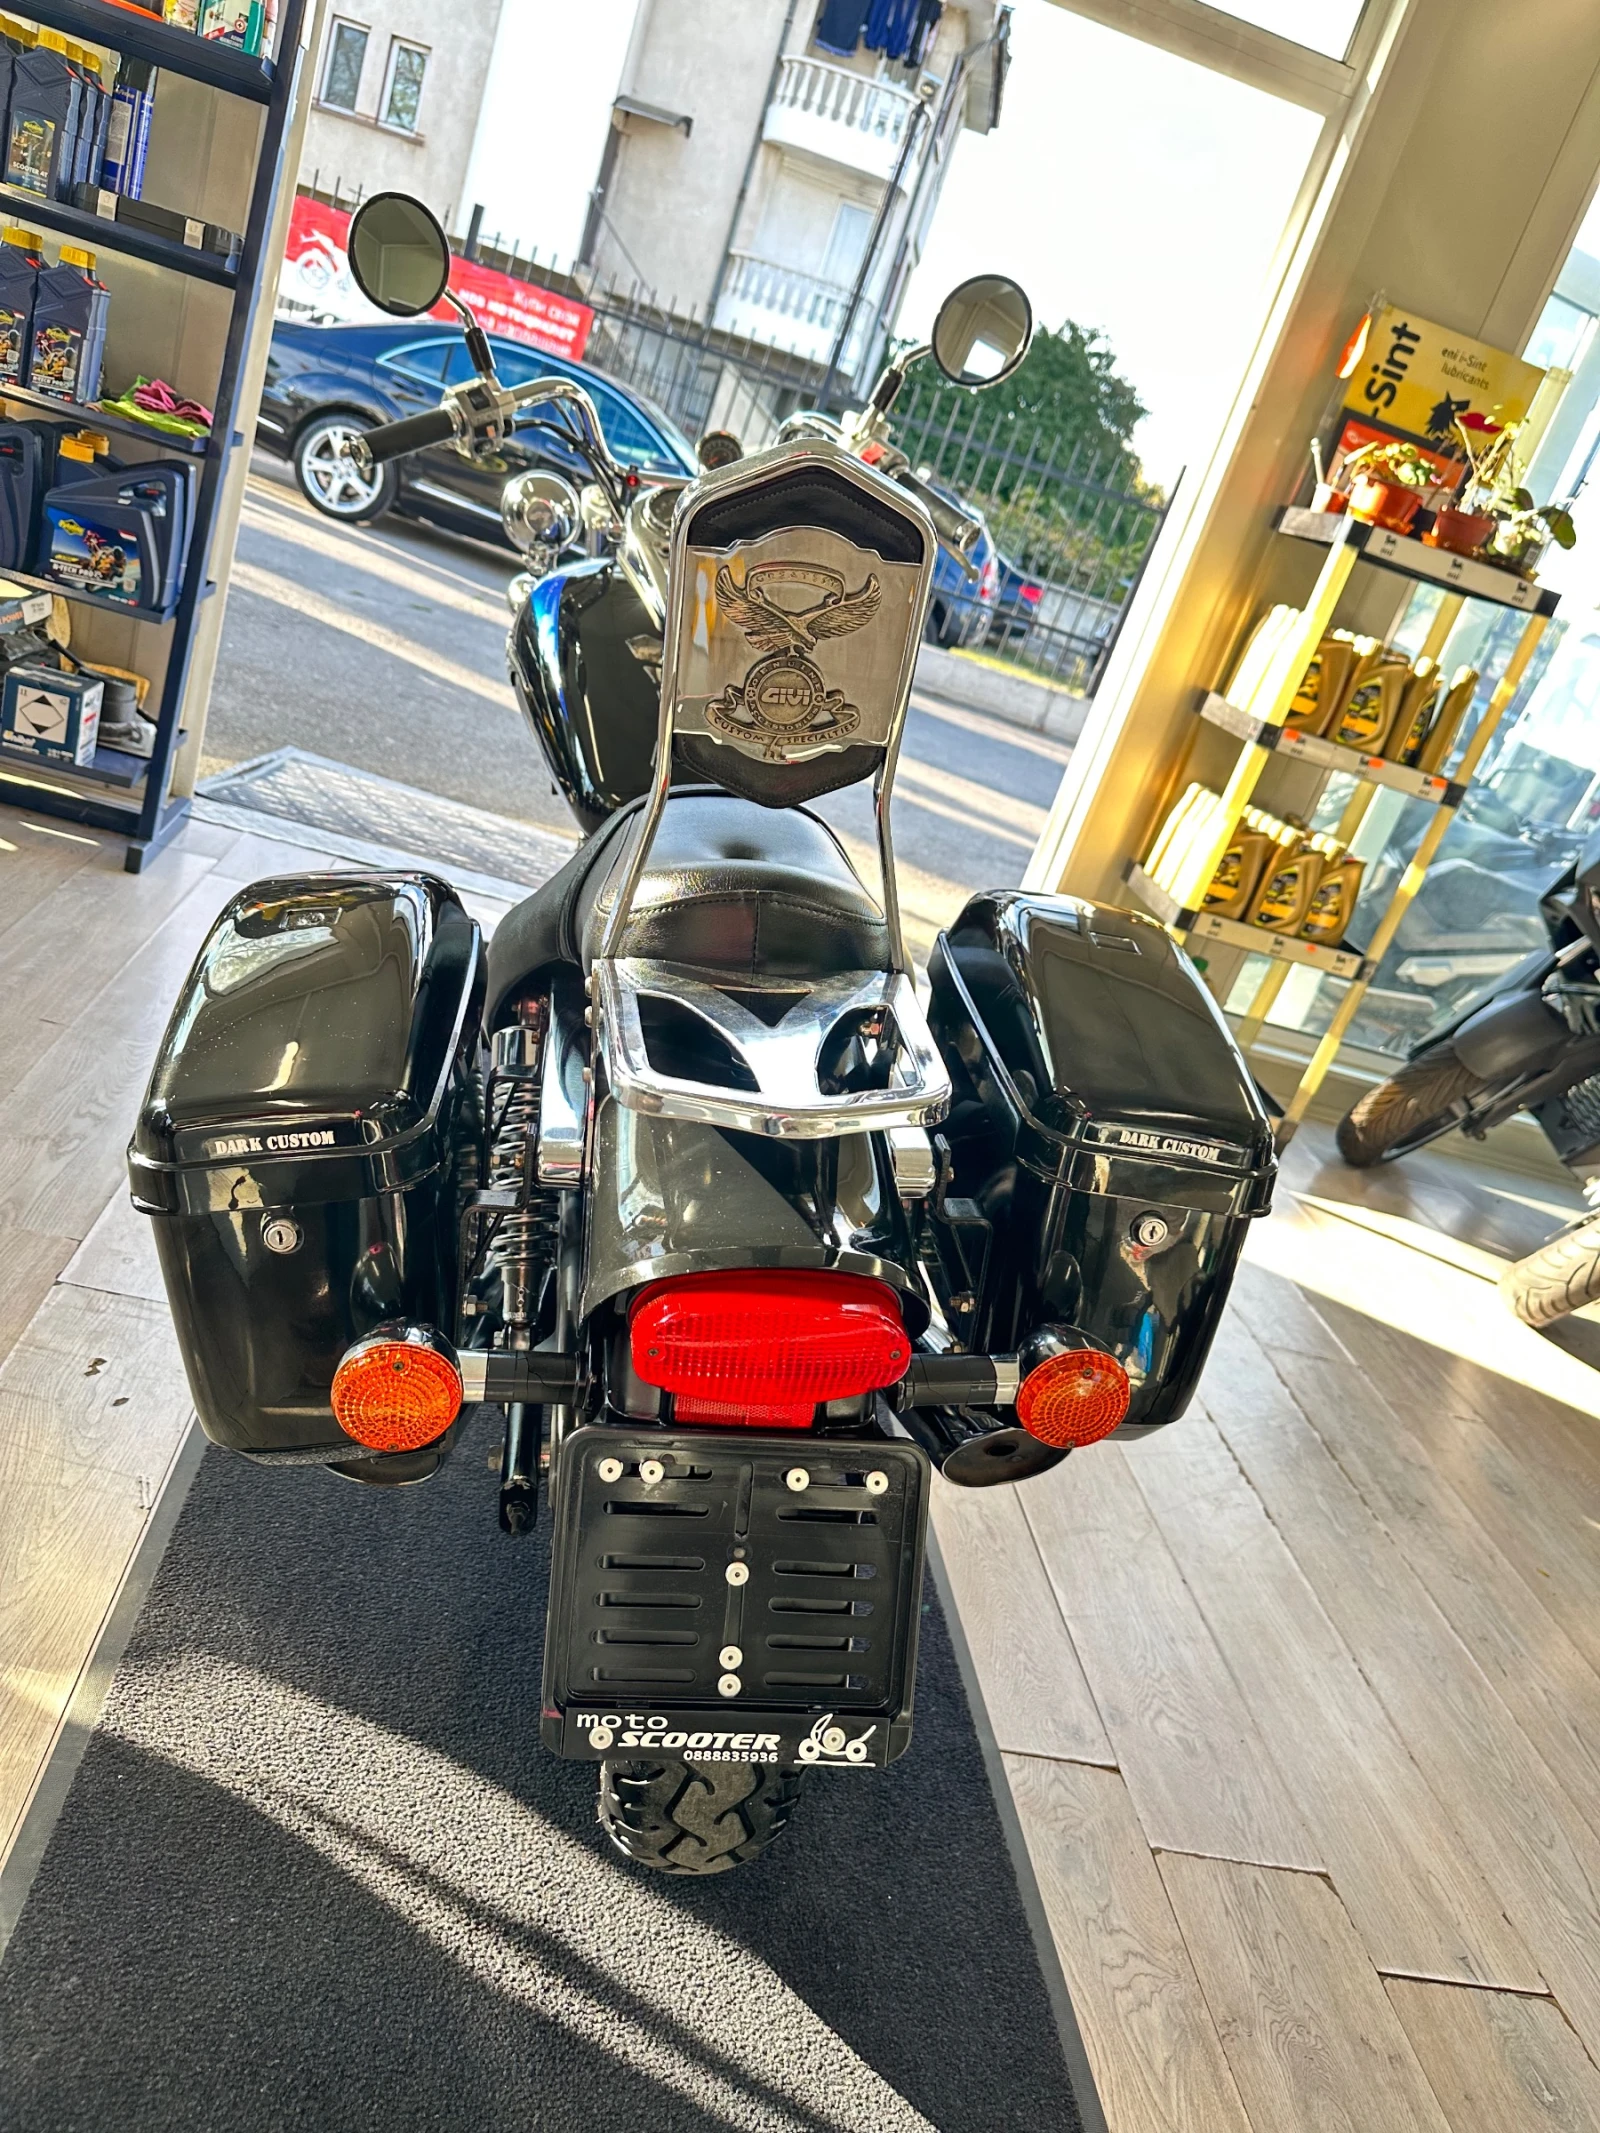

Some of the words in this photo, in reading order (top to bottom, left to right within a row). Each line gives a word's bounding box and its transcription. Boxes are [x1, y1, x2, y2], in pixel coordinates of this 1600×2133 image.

[13, 161, 39, 175] SCOOTER
[1441, 347, 1458, 360] eni
[1441, 362, 1490, 390] lubricants
[751, 661, 821, 691] GENUINE
[761, 687, 810, 706] GIVI
[714, 716, 764, 742] CUSTOM
[787, 720, 856, 744] SPECIALTIES
[215, 1138, 263, 1155] DARK
[266, 1131, 335, 1150] CUSTOM
[1120, 1130, 1160, 1149] DARK
[1162, 1138, 1220, 1160] CUSTOM
[577, 1713, 669, 1730] moto
[617, 1731, 781, 1750] SCOOTER
[683, 1750, 778, 1763] 0888835936
